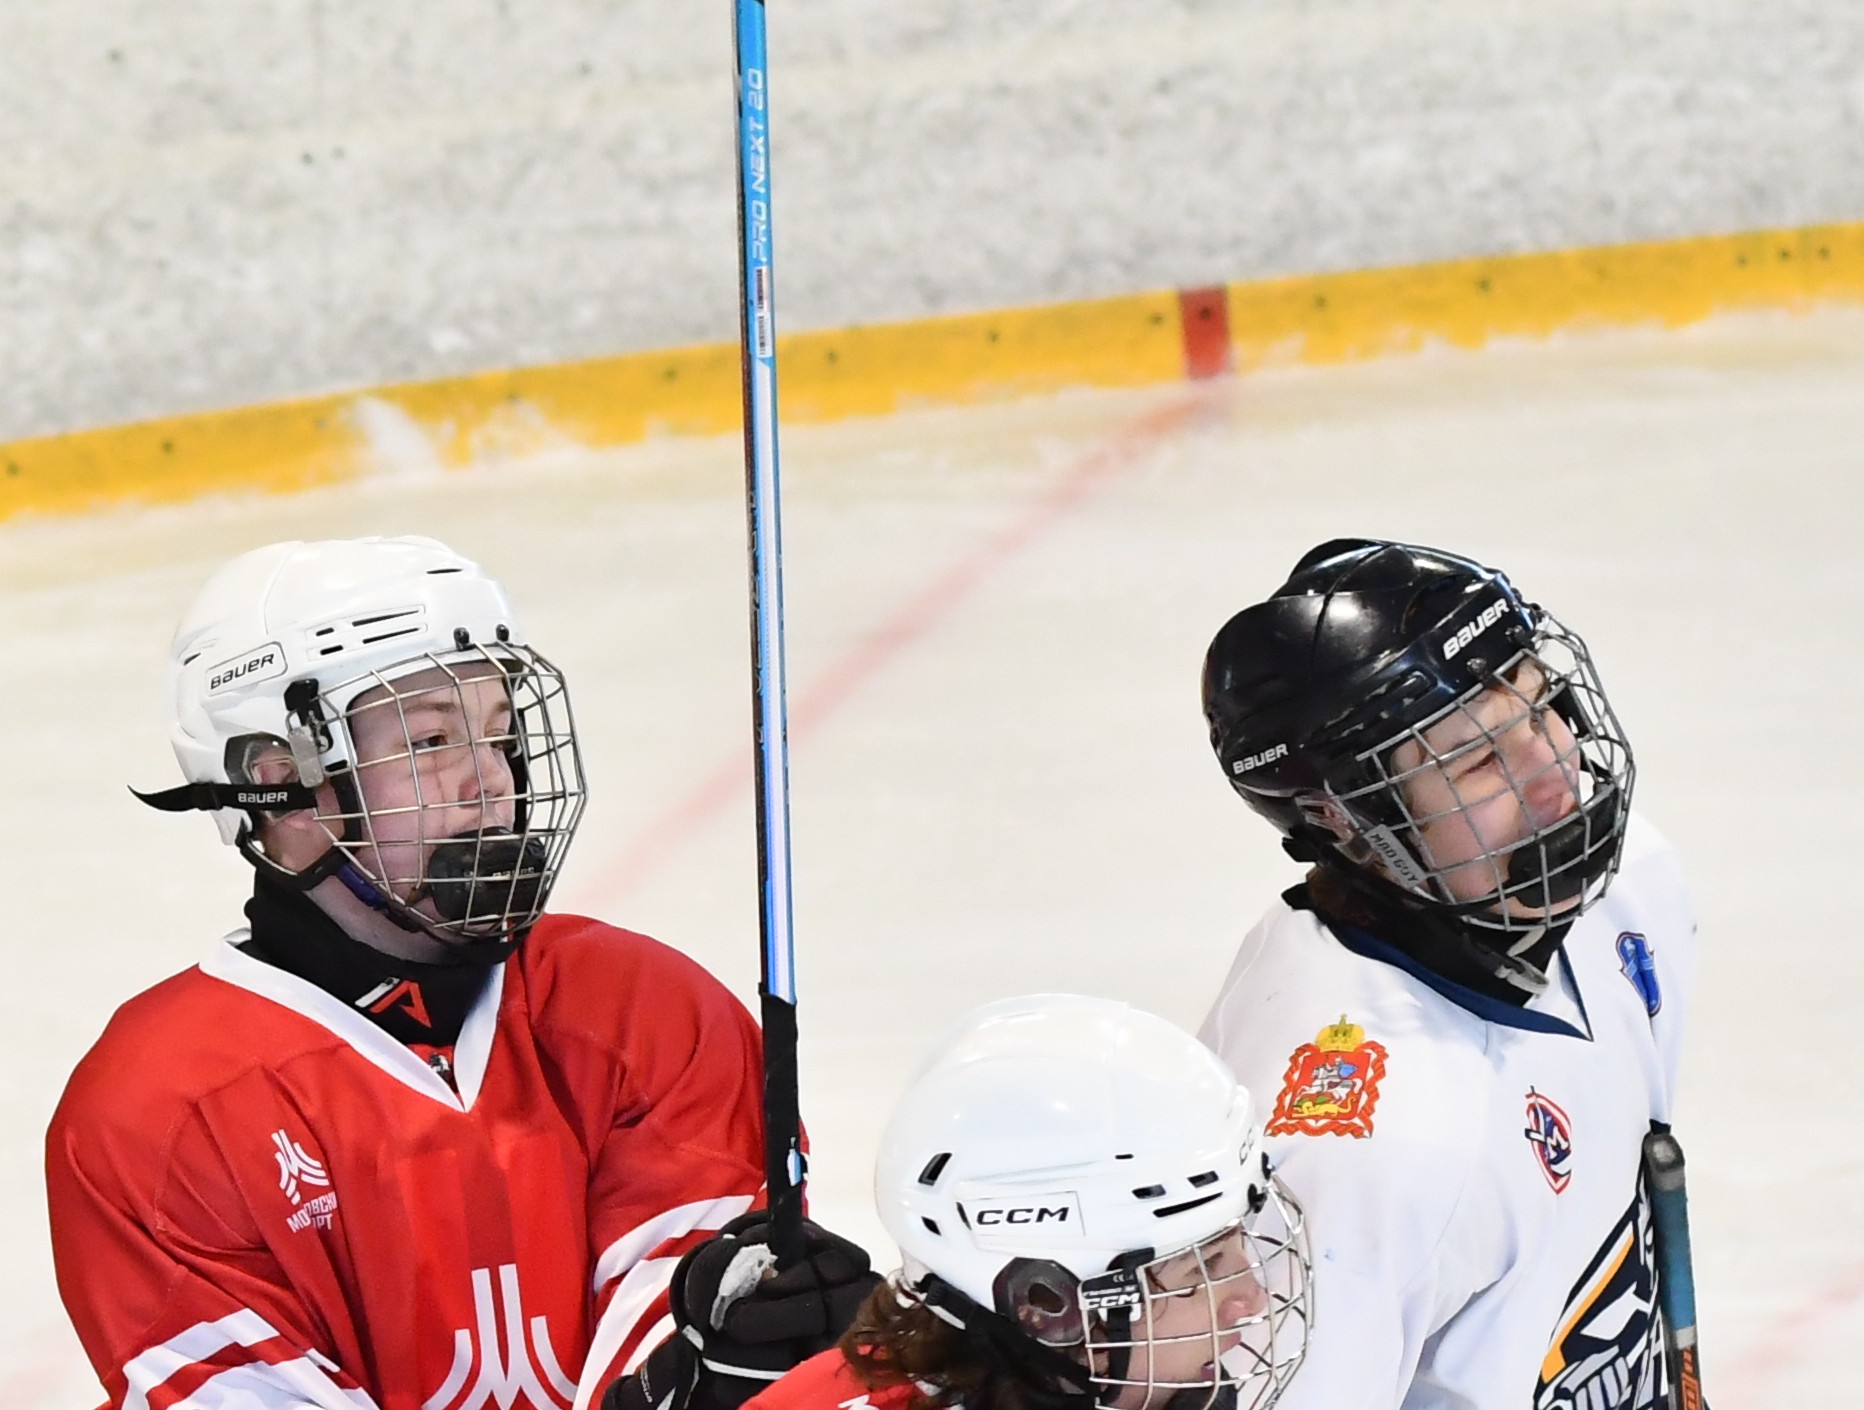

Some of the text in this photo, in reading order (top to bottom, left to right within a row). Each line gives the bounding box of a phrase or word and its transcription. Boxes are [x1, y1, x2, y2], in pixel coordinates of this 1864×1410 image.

[750, 117, 766, 193] NEXT
[752, 201, 769, 262] PRO
[1443, 598, 1510, 660] BAUER
[210, 653, 275, 690] BAUER
[1232, 743, 1289, 775] BAUER
[238, 791, 288, 804] BAUER
[976, 1206, 1071, 1227] CCM
[1085, 1293, 1140, 1309] CCM
